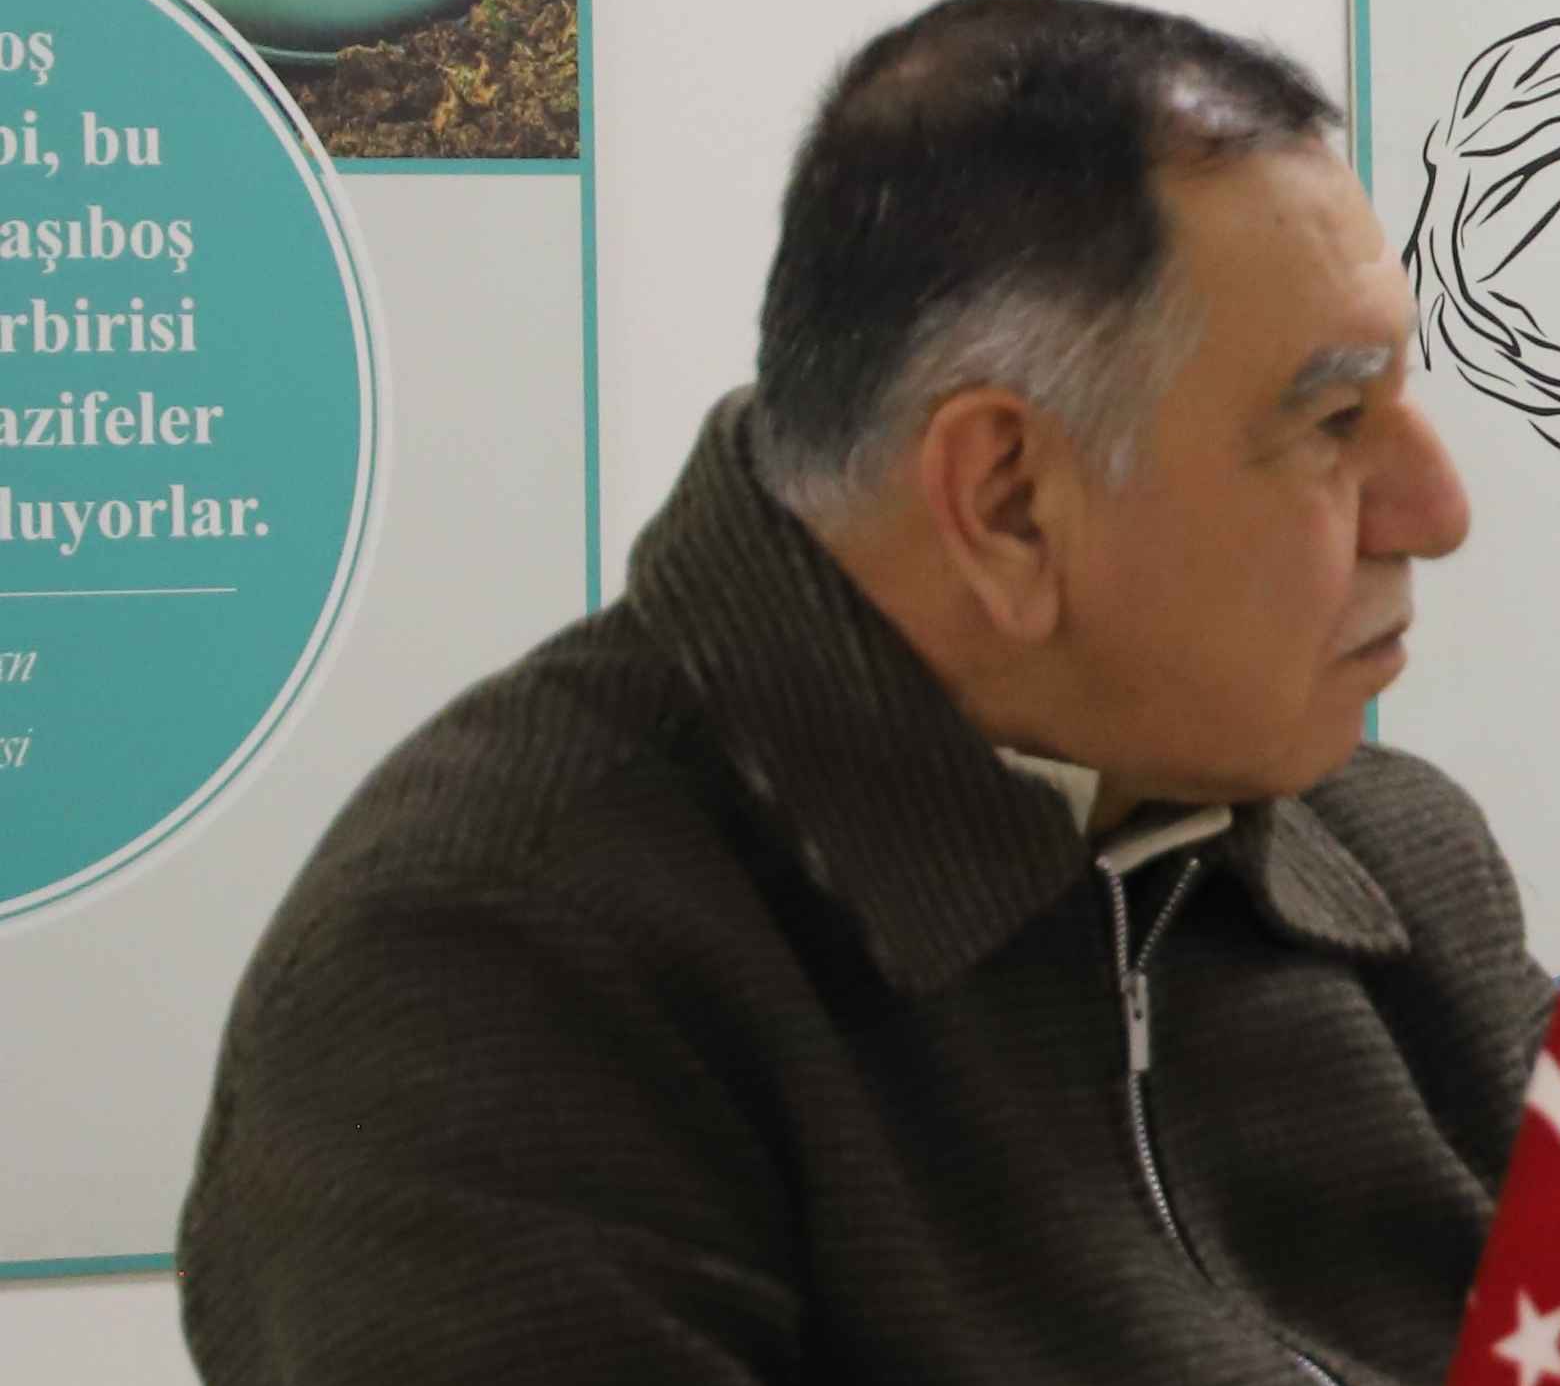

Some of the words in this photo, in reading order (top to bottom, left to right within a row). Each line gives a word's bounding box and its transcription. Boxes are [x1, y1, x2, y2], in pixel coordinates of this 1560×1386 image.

[0, 32, 55, 85] oş
[82, 111, 161, 166] bu
[0, 205, 194, 273] aşıboş
[0, 297, 196, 353] rbirisi
[0, 391, 224, 447] azifeler
[0, 484, 269, 556] luyorlar.
